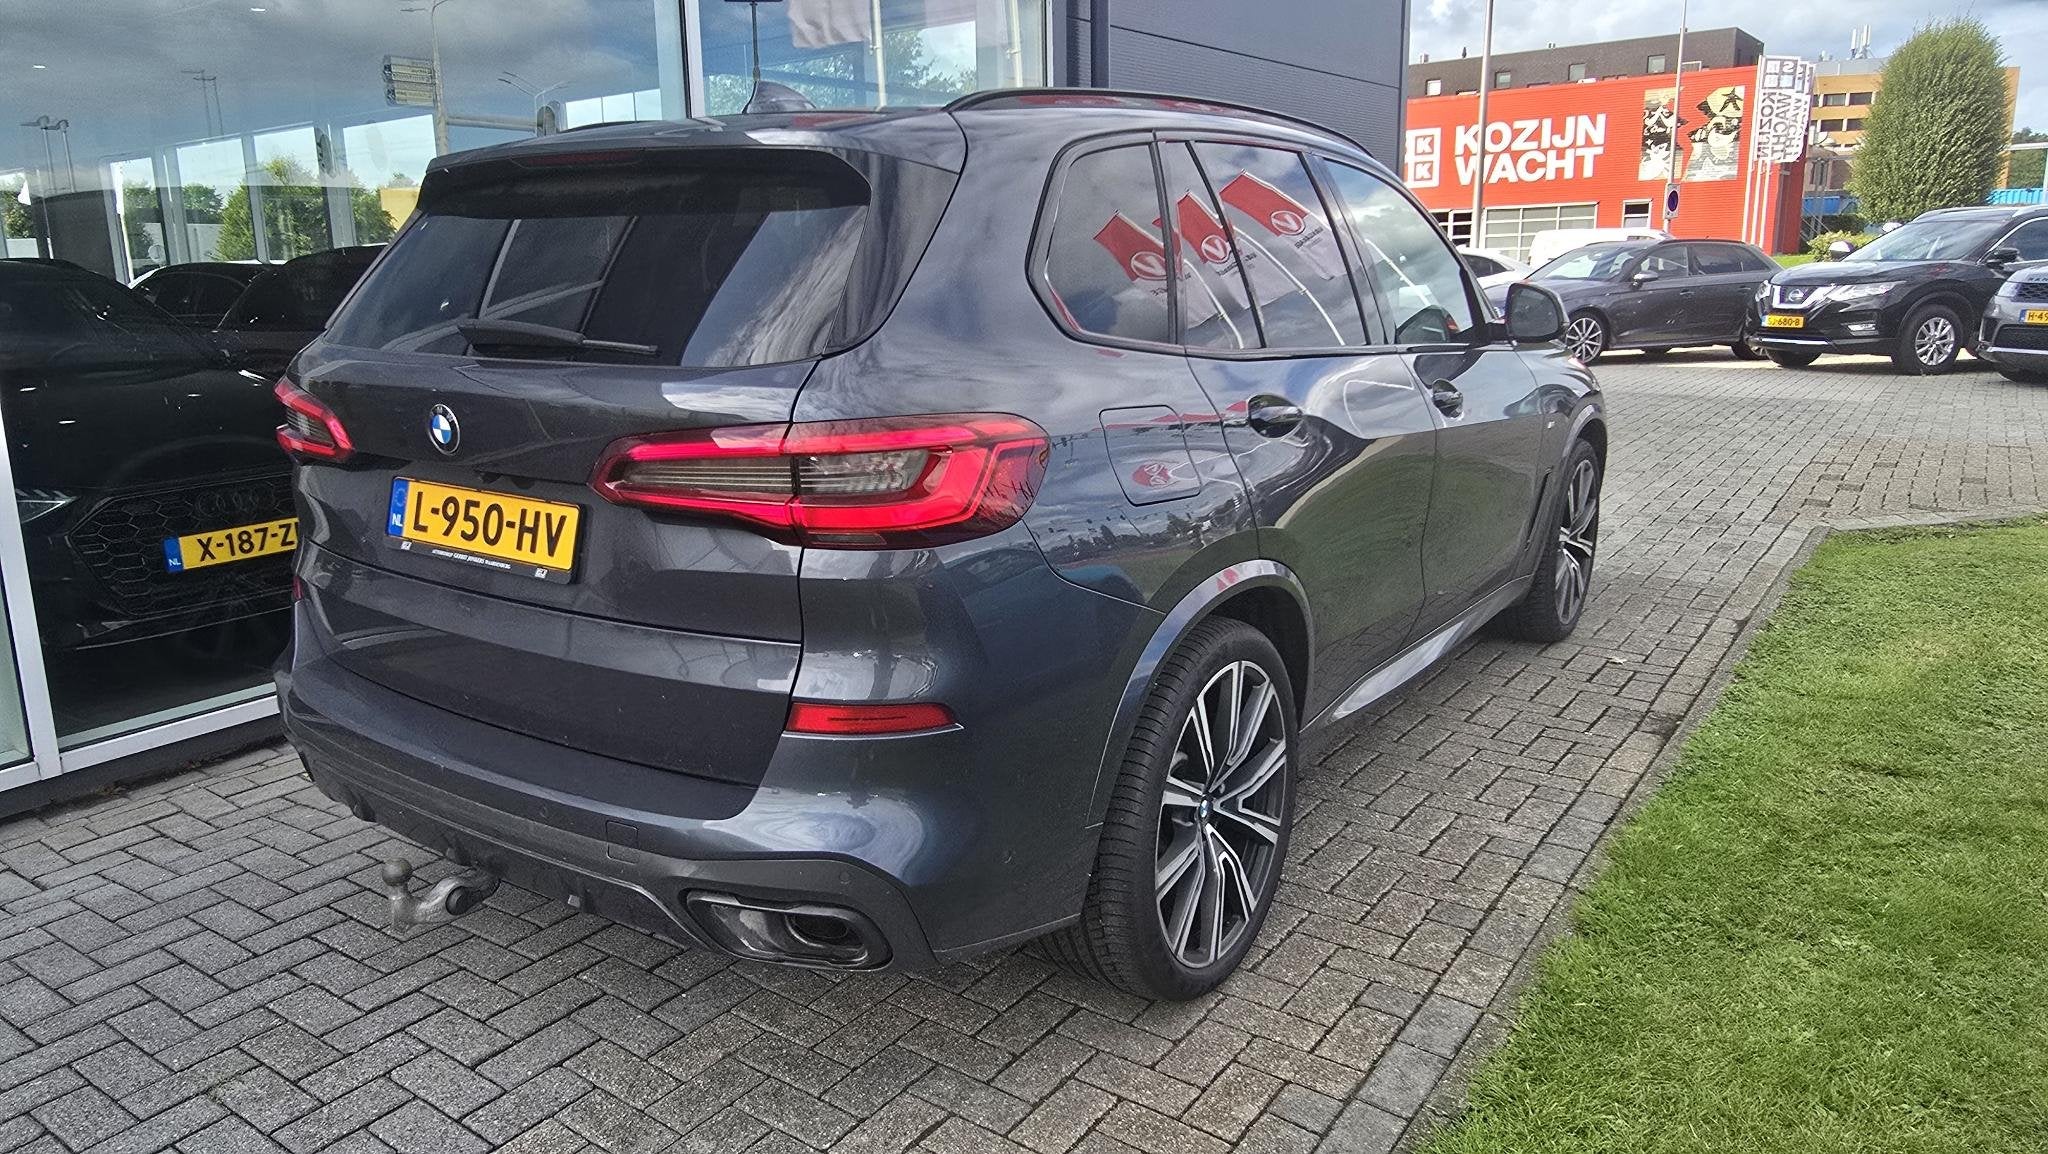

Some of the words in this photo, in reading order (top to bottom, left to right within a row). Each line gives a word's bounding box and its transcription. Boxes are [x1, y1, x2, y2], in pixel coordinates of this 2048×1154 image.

[1455, 113, 1606, 156] KOZIJN
[1415, 136, 1434, 155] K
[1414, 161, 1433, 181] K
[1455, 146, 1604, 186] WACHT
[391, 513, 404, 527] NL
[413, 491, 568, 558] L-950-HV
[168, 558, 181, 567] NL
